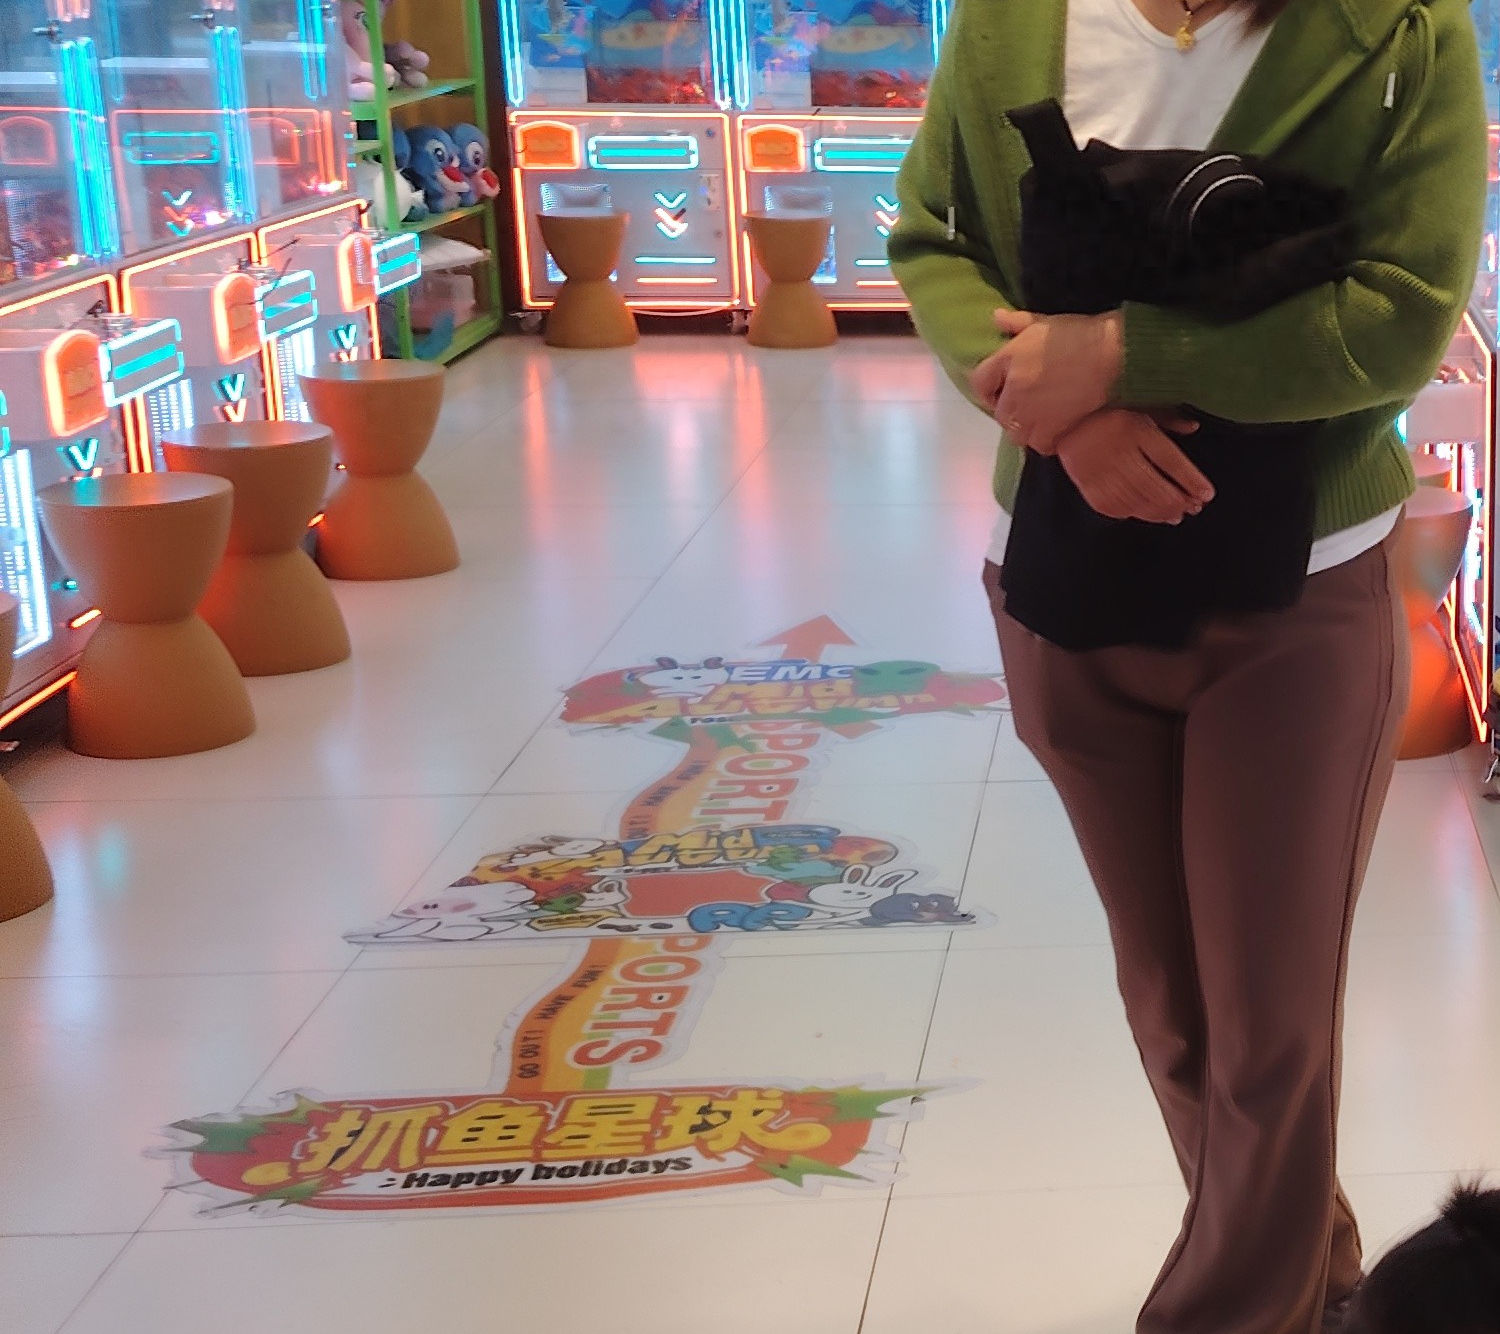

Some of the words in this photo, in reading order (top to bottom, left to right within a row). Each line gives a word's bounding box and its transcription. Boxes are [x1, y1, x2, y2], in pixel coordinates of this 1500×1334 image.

[308, 1088, 832, 1170] 抓鱼星球
[400, 1165, 524, 1191] Happy
[530, 1153, 694, 1182] holidays
